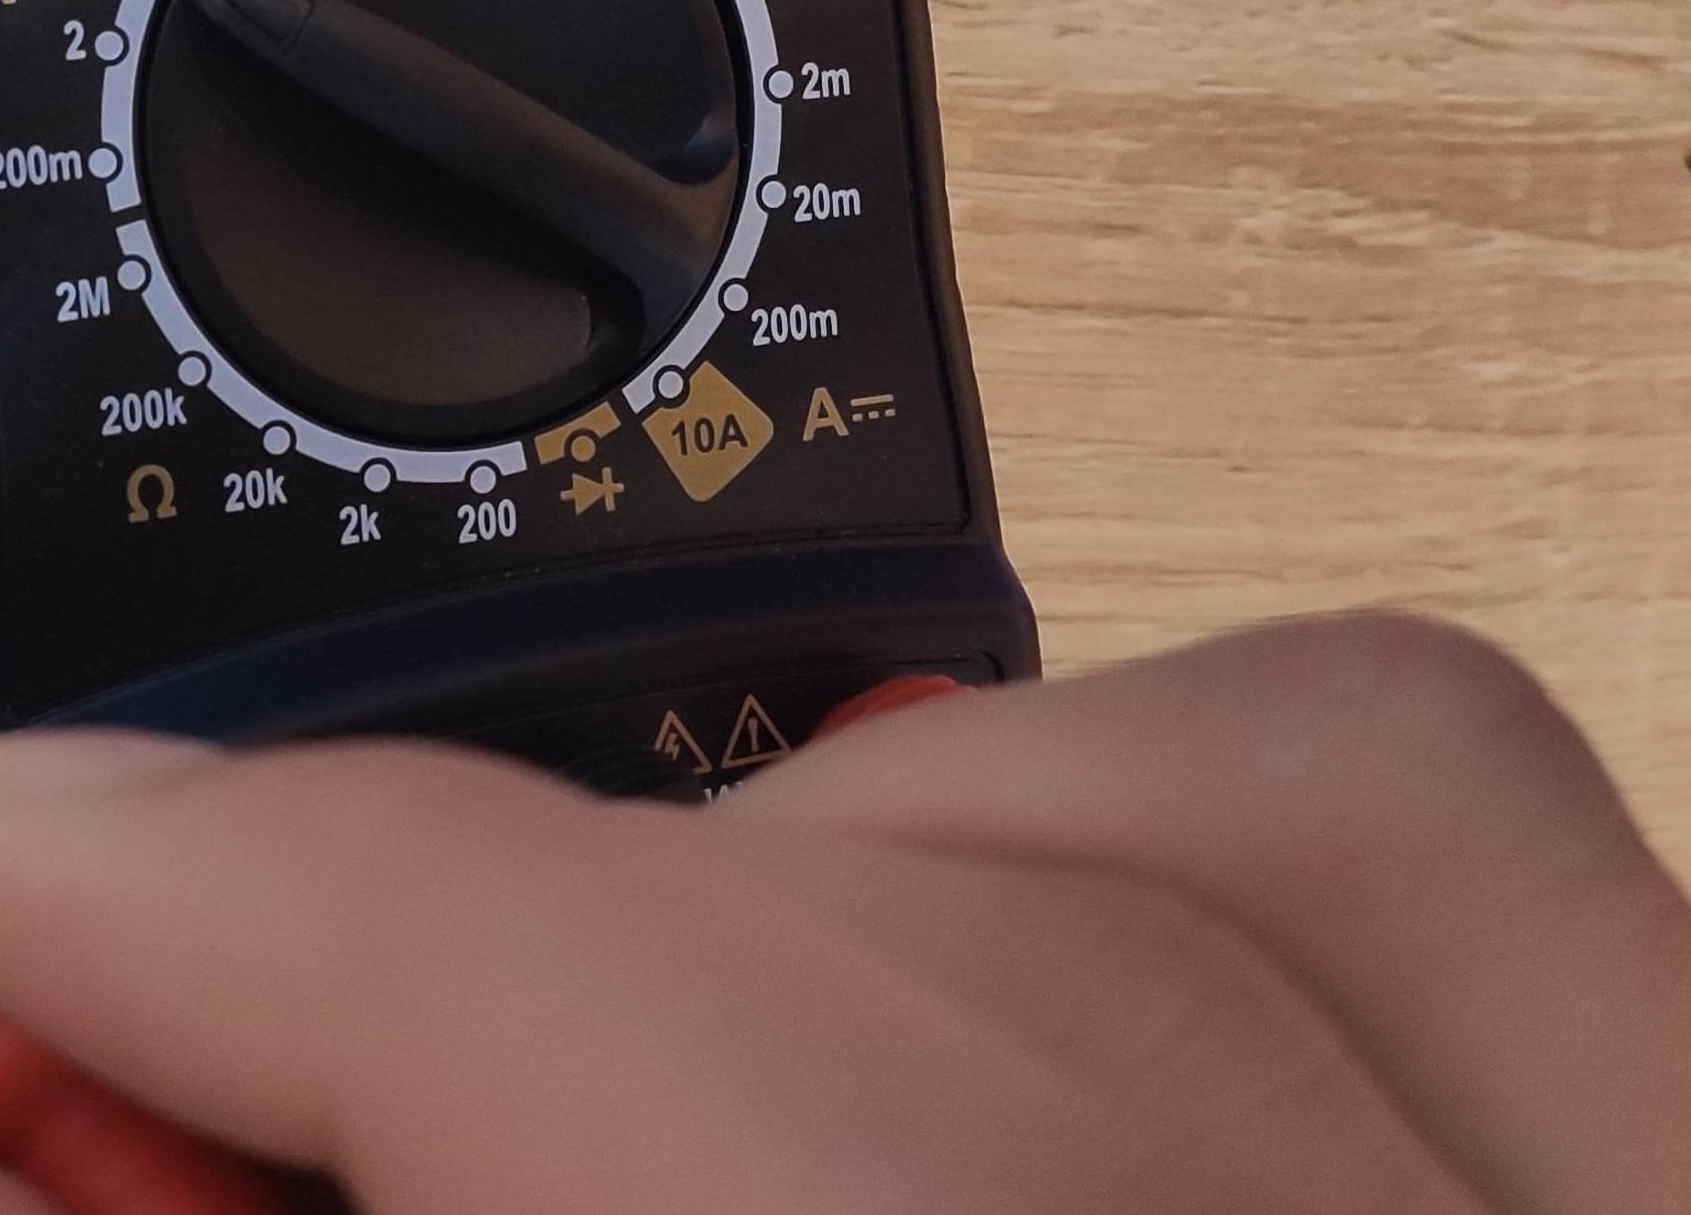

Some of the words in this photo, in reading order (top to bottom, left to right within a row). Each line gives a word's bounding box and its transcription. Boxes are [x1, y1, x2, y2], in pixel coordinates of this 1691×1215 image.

[63, 20, 86, 60] 2
[801, 62, 851, 100] 2m
[793, 183, 861, 222] 20m
[55, 277, 111, 322] 2M
[751, 304, 839, 346] 200m
[100, 387, 187, 436] 200k
[670, 415, 749, 456] 10A
[223, 468, 287, 512] 20k
[339, 505, 381, 545] 2k
[457, 499, 517, 544] 200
